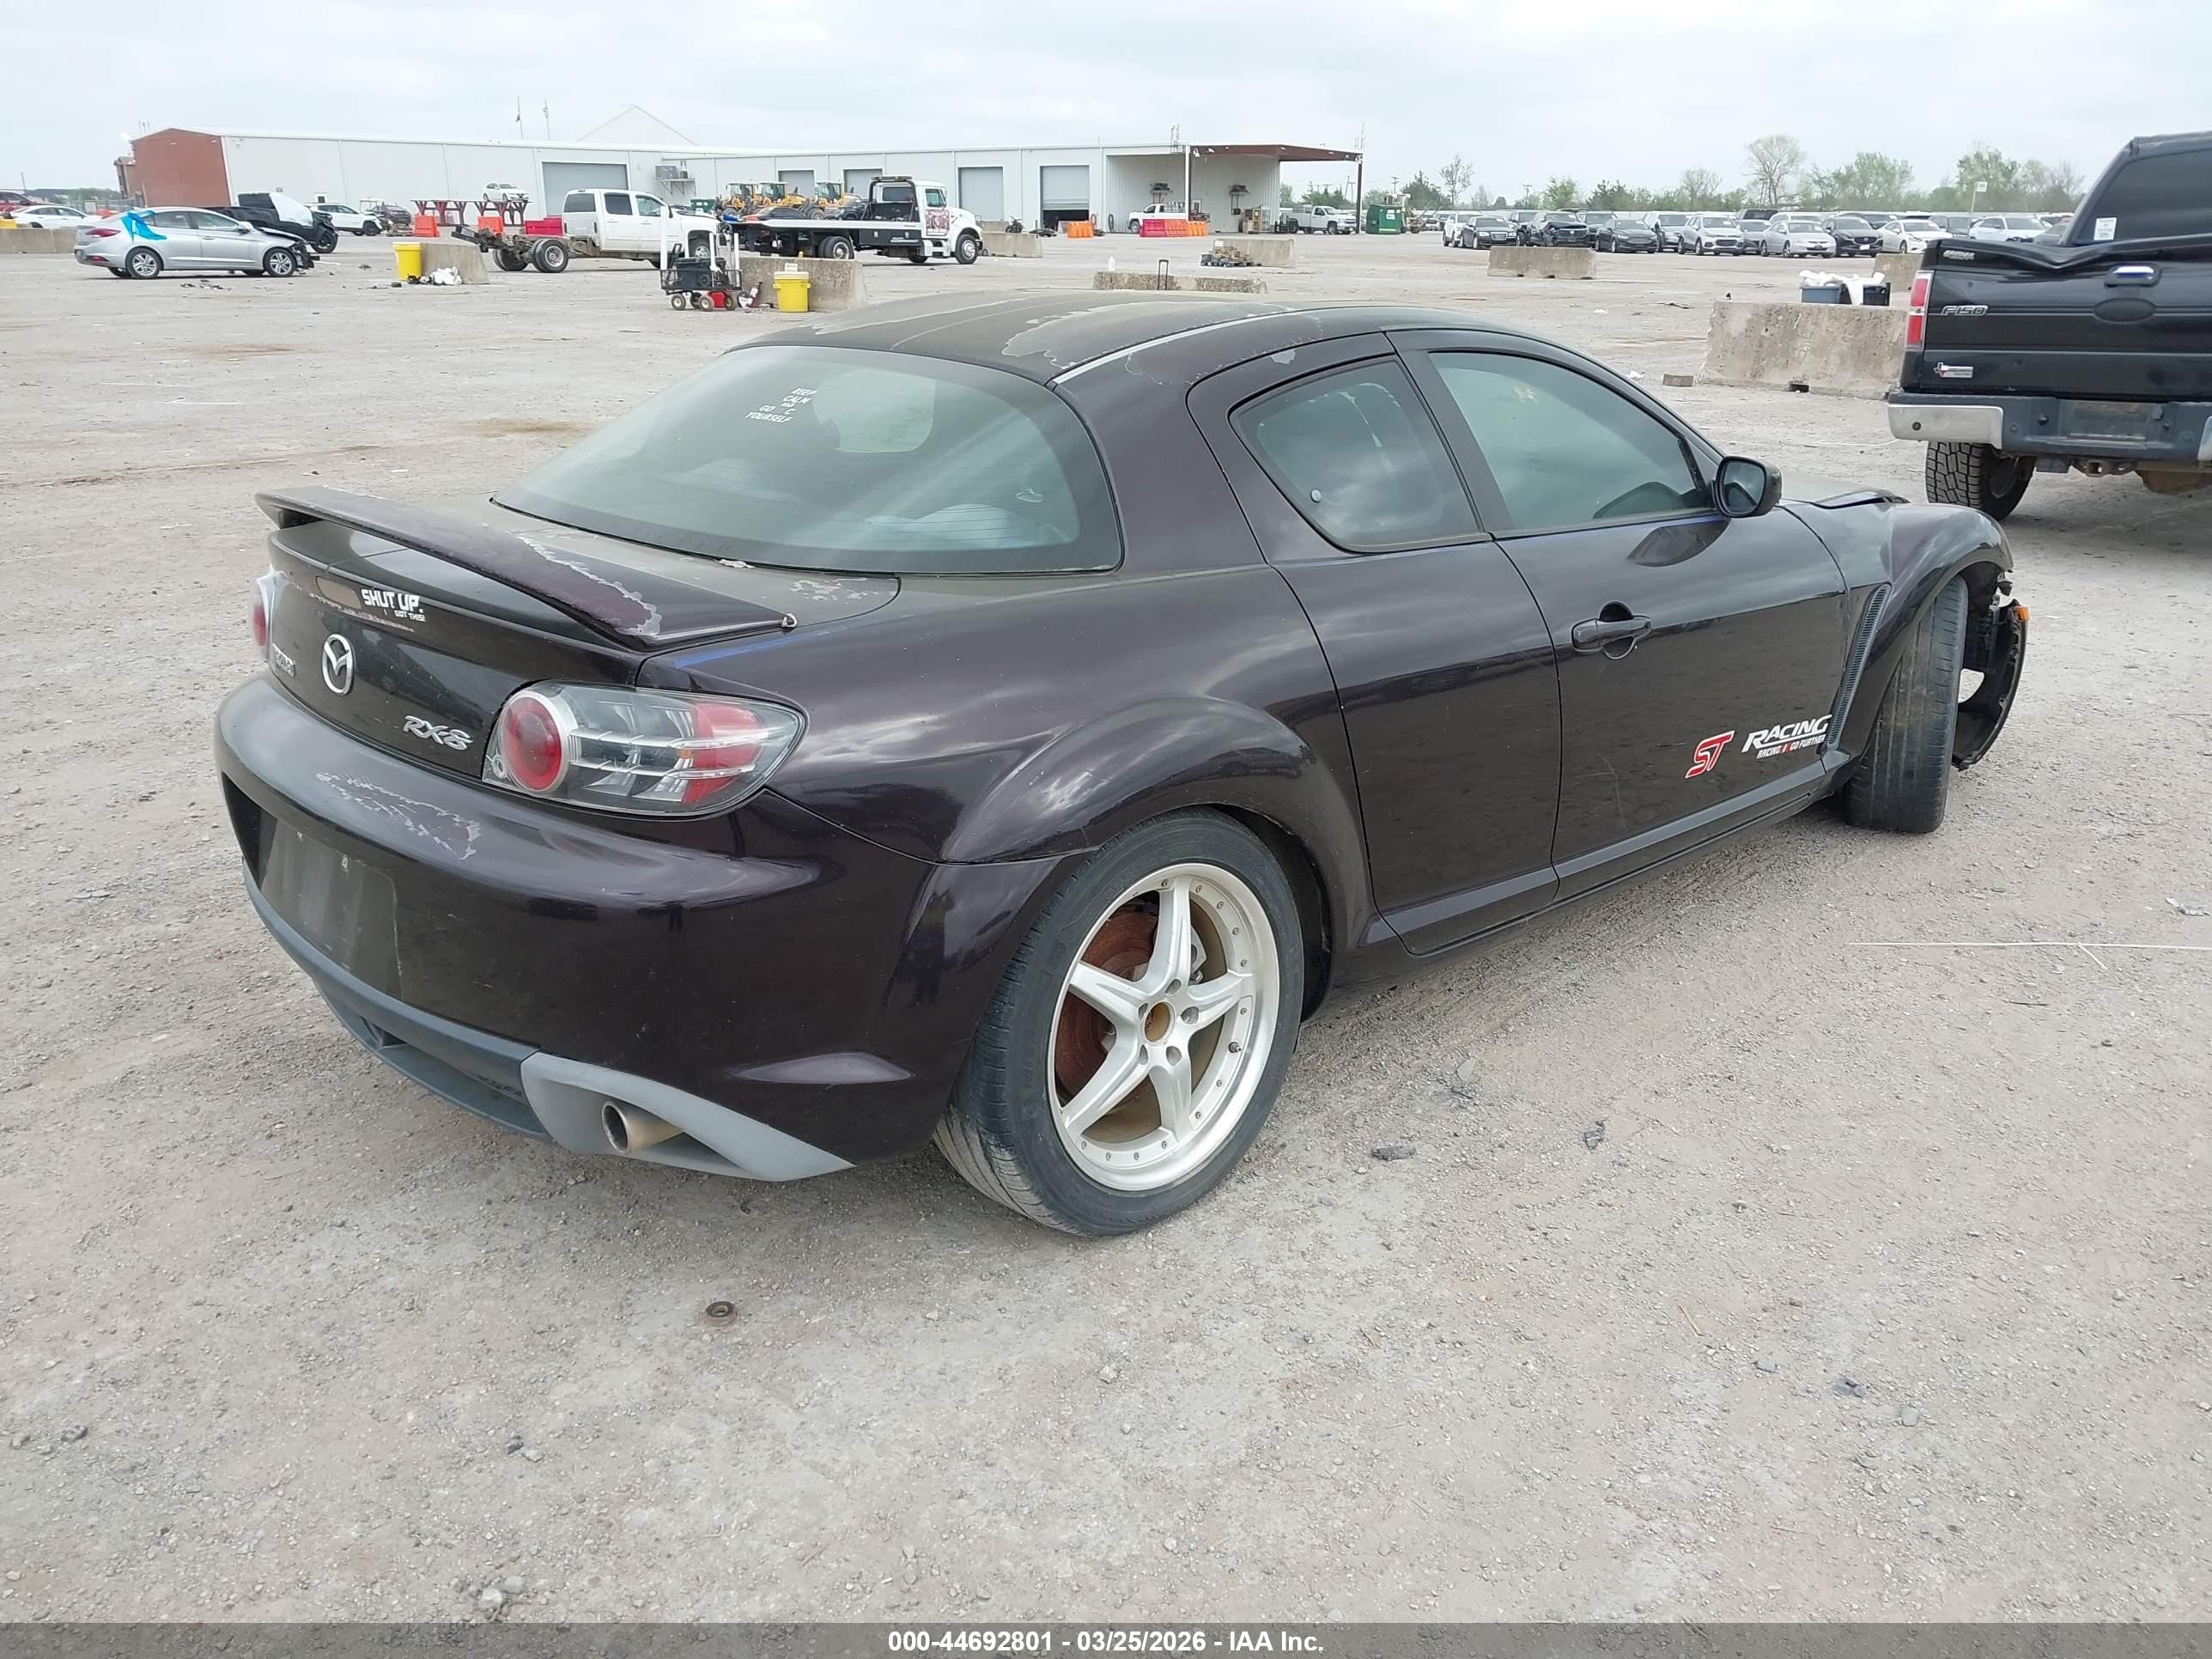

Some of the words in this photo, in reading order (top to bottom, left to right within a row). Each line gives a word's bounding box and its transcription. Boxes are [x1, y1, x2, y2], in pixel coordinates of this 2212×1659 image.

[744, 411, 794, 422] YOURSELF
[361, 589, 395, 608] SHUT
[398, 592, 423, 613] UP.
[394, 610, 407, 618] GOT
[403, 715, 474, 750] RX-8
[1741, 714, 1832, 753] RACING
[1685, 730, 1735, 779] ST
[1756, 745, 1781, 759] RACING
[1789, 741, 1800, 751] GO
